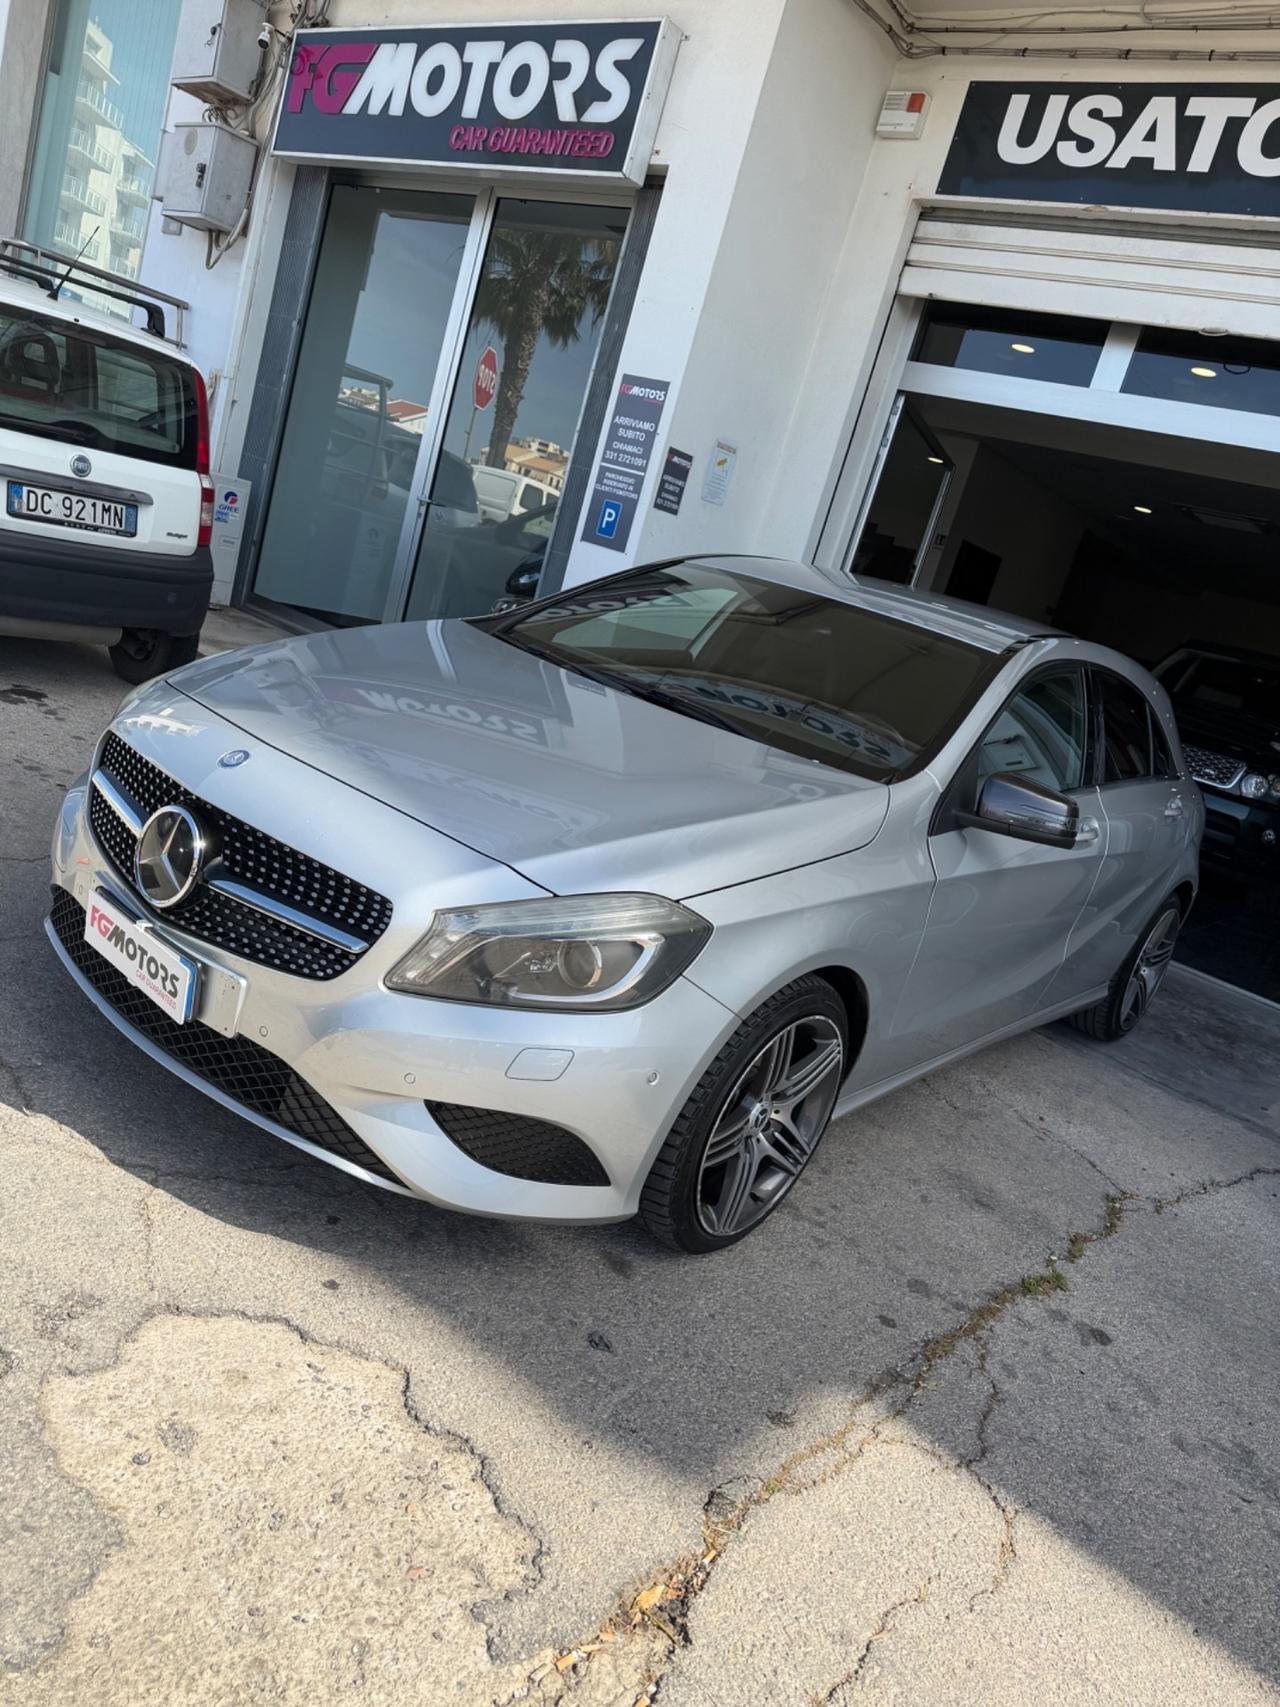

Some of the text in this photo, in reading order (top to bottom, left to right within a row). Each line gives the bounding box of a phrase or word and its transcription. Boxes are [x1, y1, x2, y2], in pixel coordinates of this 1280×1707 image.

[450, 126, 615, 158] CAR GUARANTEED
[613, 415, 655, 431] ARRIVIAMO
[617, 427, 646, 441] SUBITO
[612, 441, 644, 454] CHIAMACI
[26, 489, 52, 515] DC
[62, 496, 124, 529] 921MN
[601, 508, 616, 529] P
